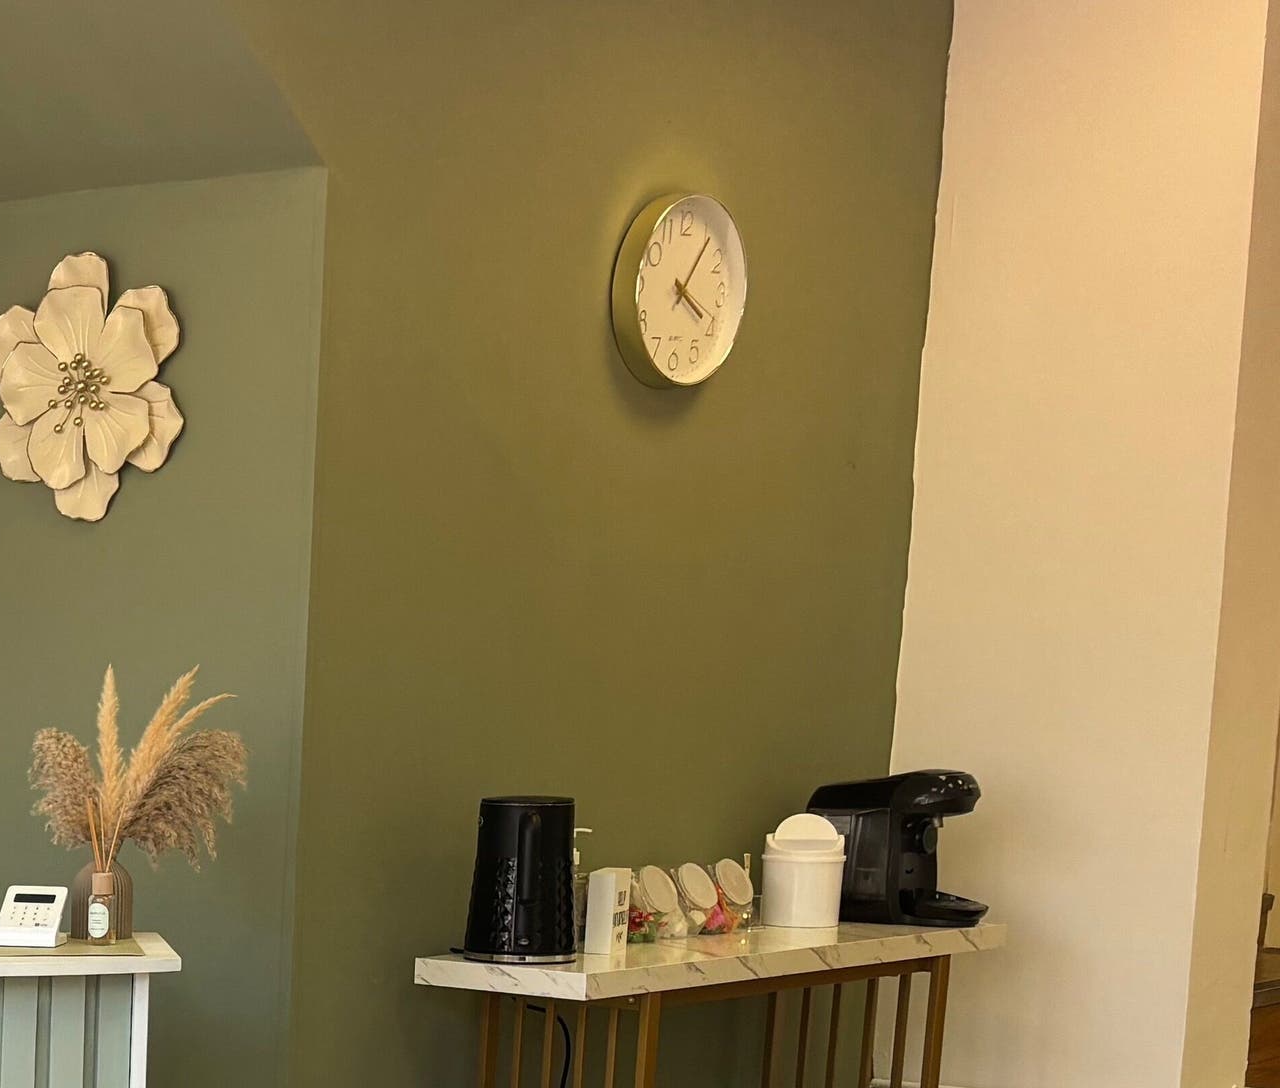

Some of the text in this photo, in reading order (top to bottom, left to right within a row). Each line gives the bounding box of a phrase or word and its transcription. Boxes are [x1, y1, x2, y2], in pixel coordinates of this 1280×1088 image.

[662, 217, 673, 245] 11
[680, 210, 694, 236] 12
[711, 248, 722, 274] 2
[715, 281, 726, 308] 3
[705, 316, 715, 337] 4
[651, 336, 661, 360] 7
[668, 347, 679, 371] 6
[689, 339, 699, 364] 5
